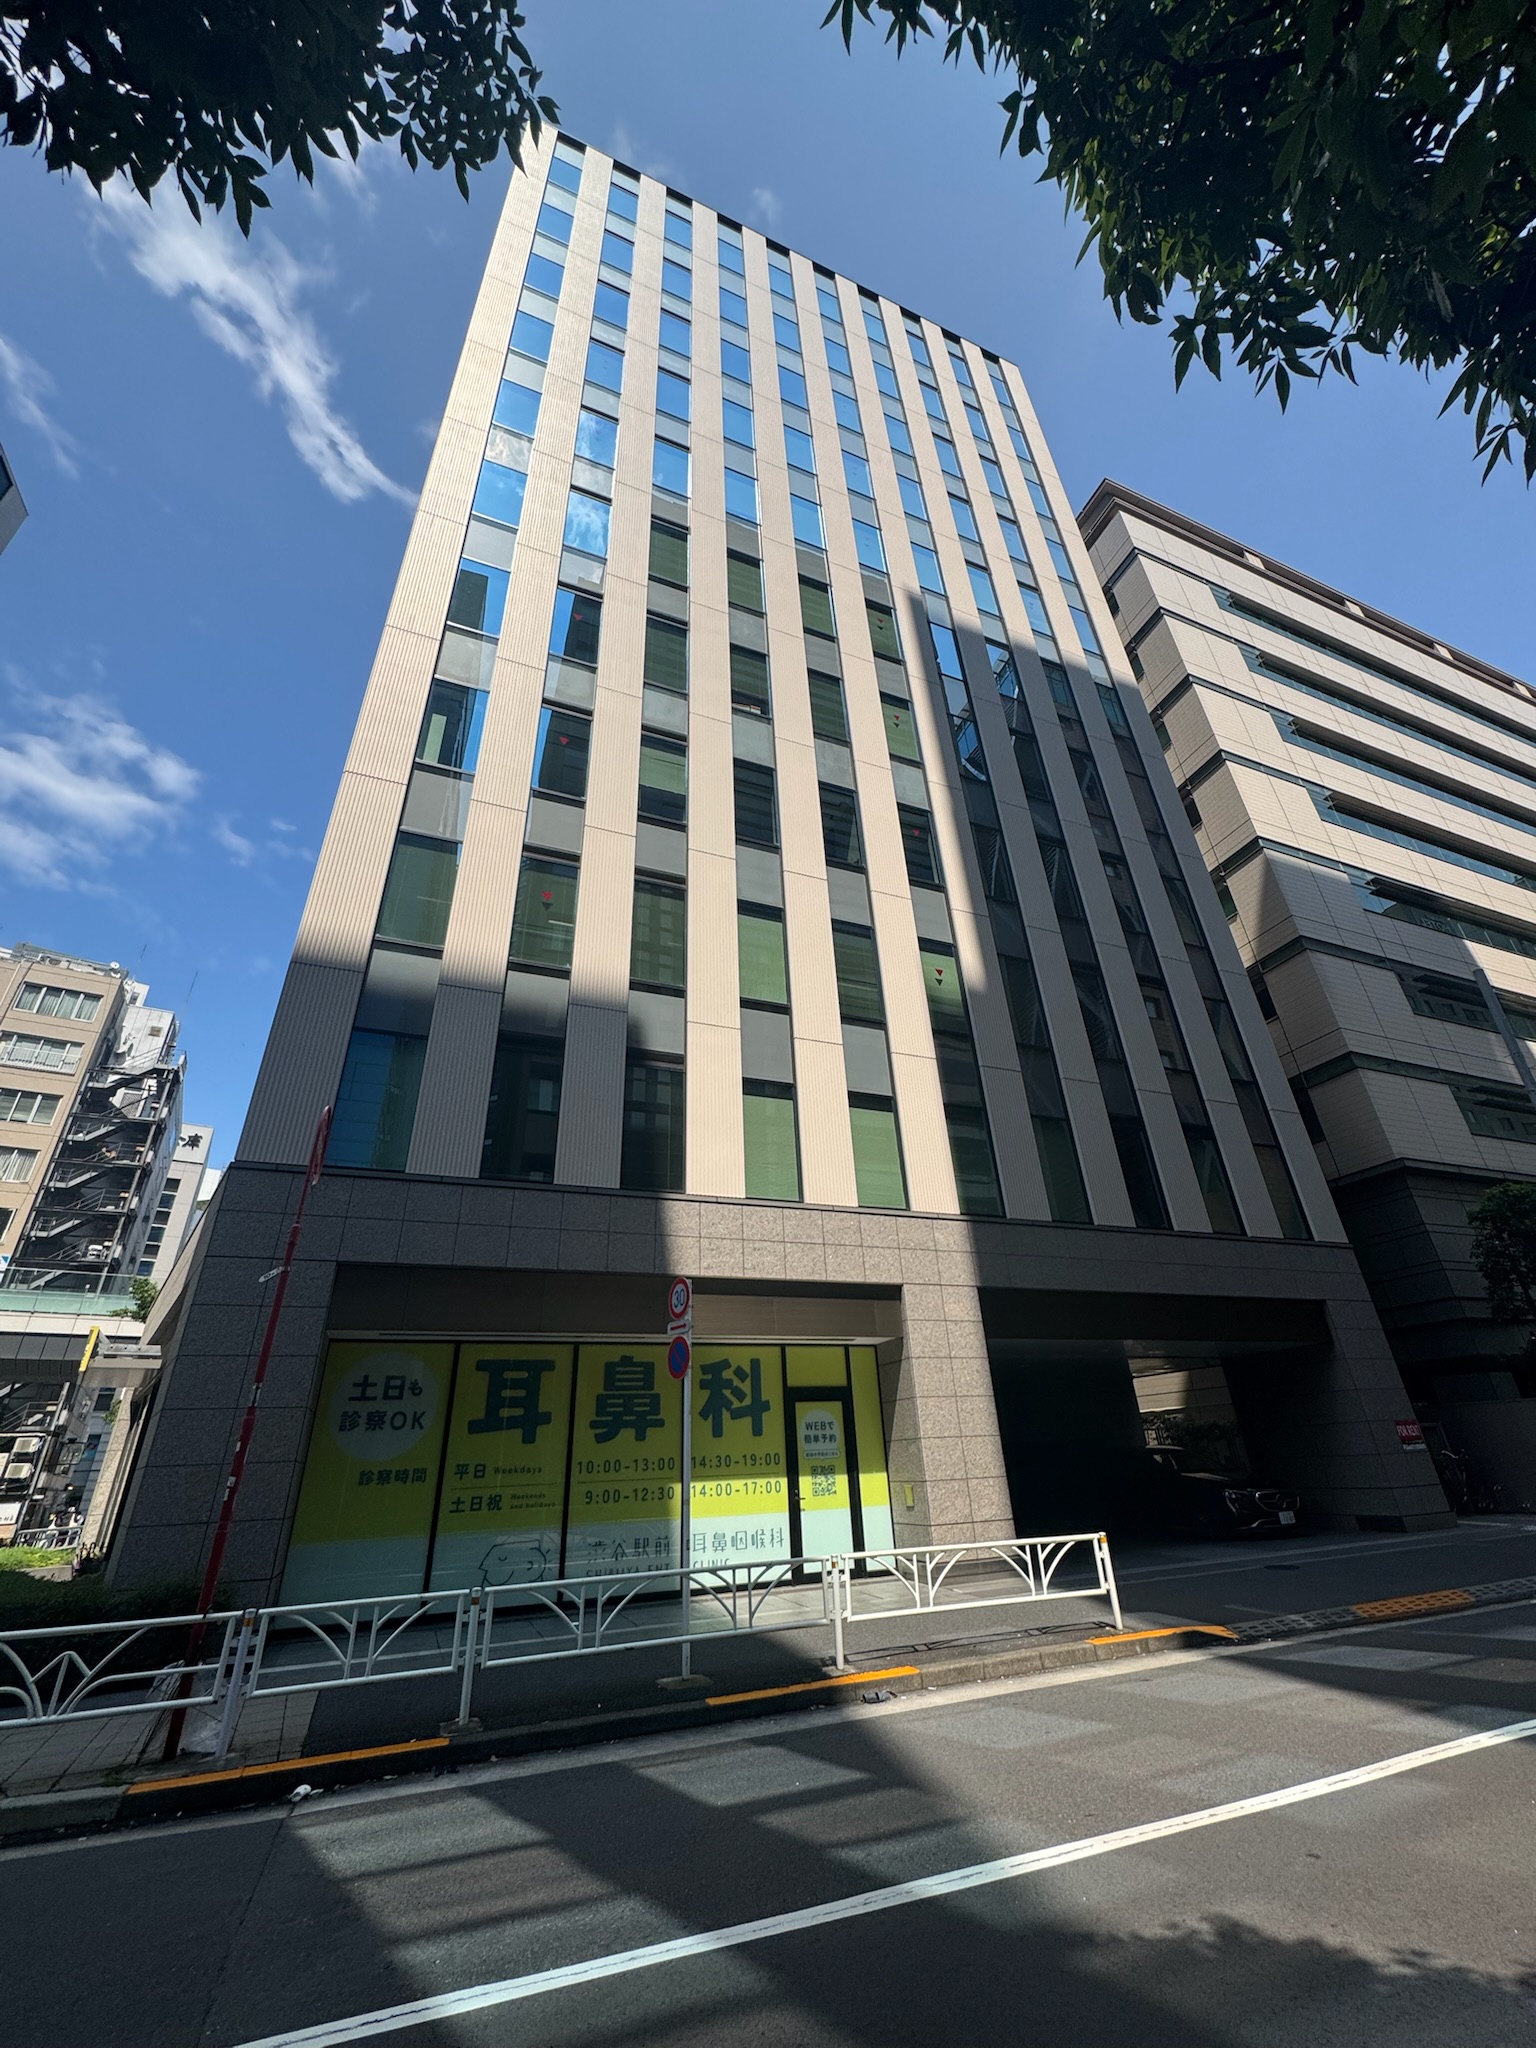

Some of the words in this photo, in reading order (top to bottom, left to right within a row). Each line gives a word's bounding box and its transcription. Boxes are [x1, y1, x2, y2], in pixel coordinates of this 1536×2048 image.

[673, 1288, 685, 1309] 30
[348, 1374, 423, 1402] 土日も
[338, 1410, 426, 1432] 診察OK
[804, 1421, 834, 1431] WEBで
[358, 1467, 427, 1486] 診察時間
[453, 1463, 487, 1480] 平日
[494, 1465, 542, 1476] Weekdays
[577, 1457, 676, 1475] 10:00-13:00
[691, 1452, 781, 1470] 14:30-19:00
[449, 1494, 502, 1514] 土日祝
[585, 1486, 675, 1505] 9:00-12:30
[691, 1479, 782, 1498] 14:00-17:00
